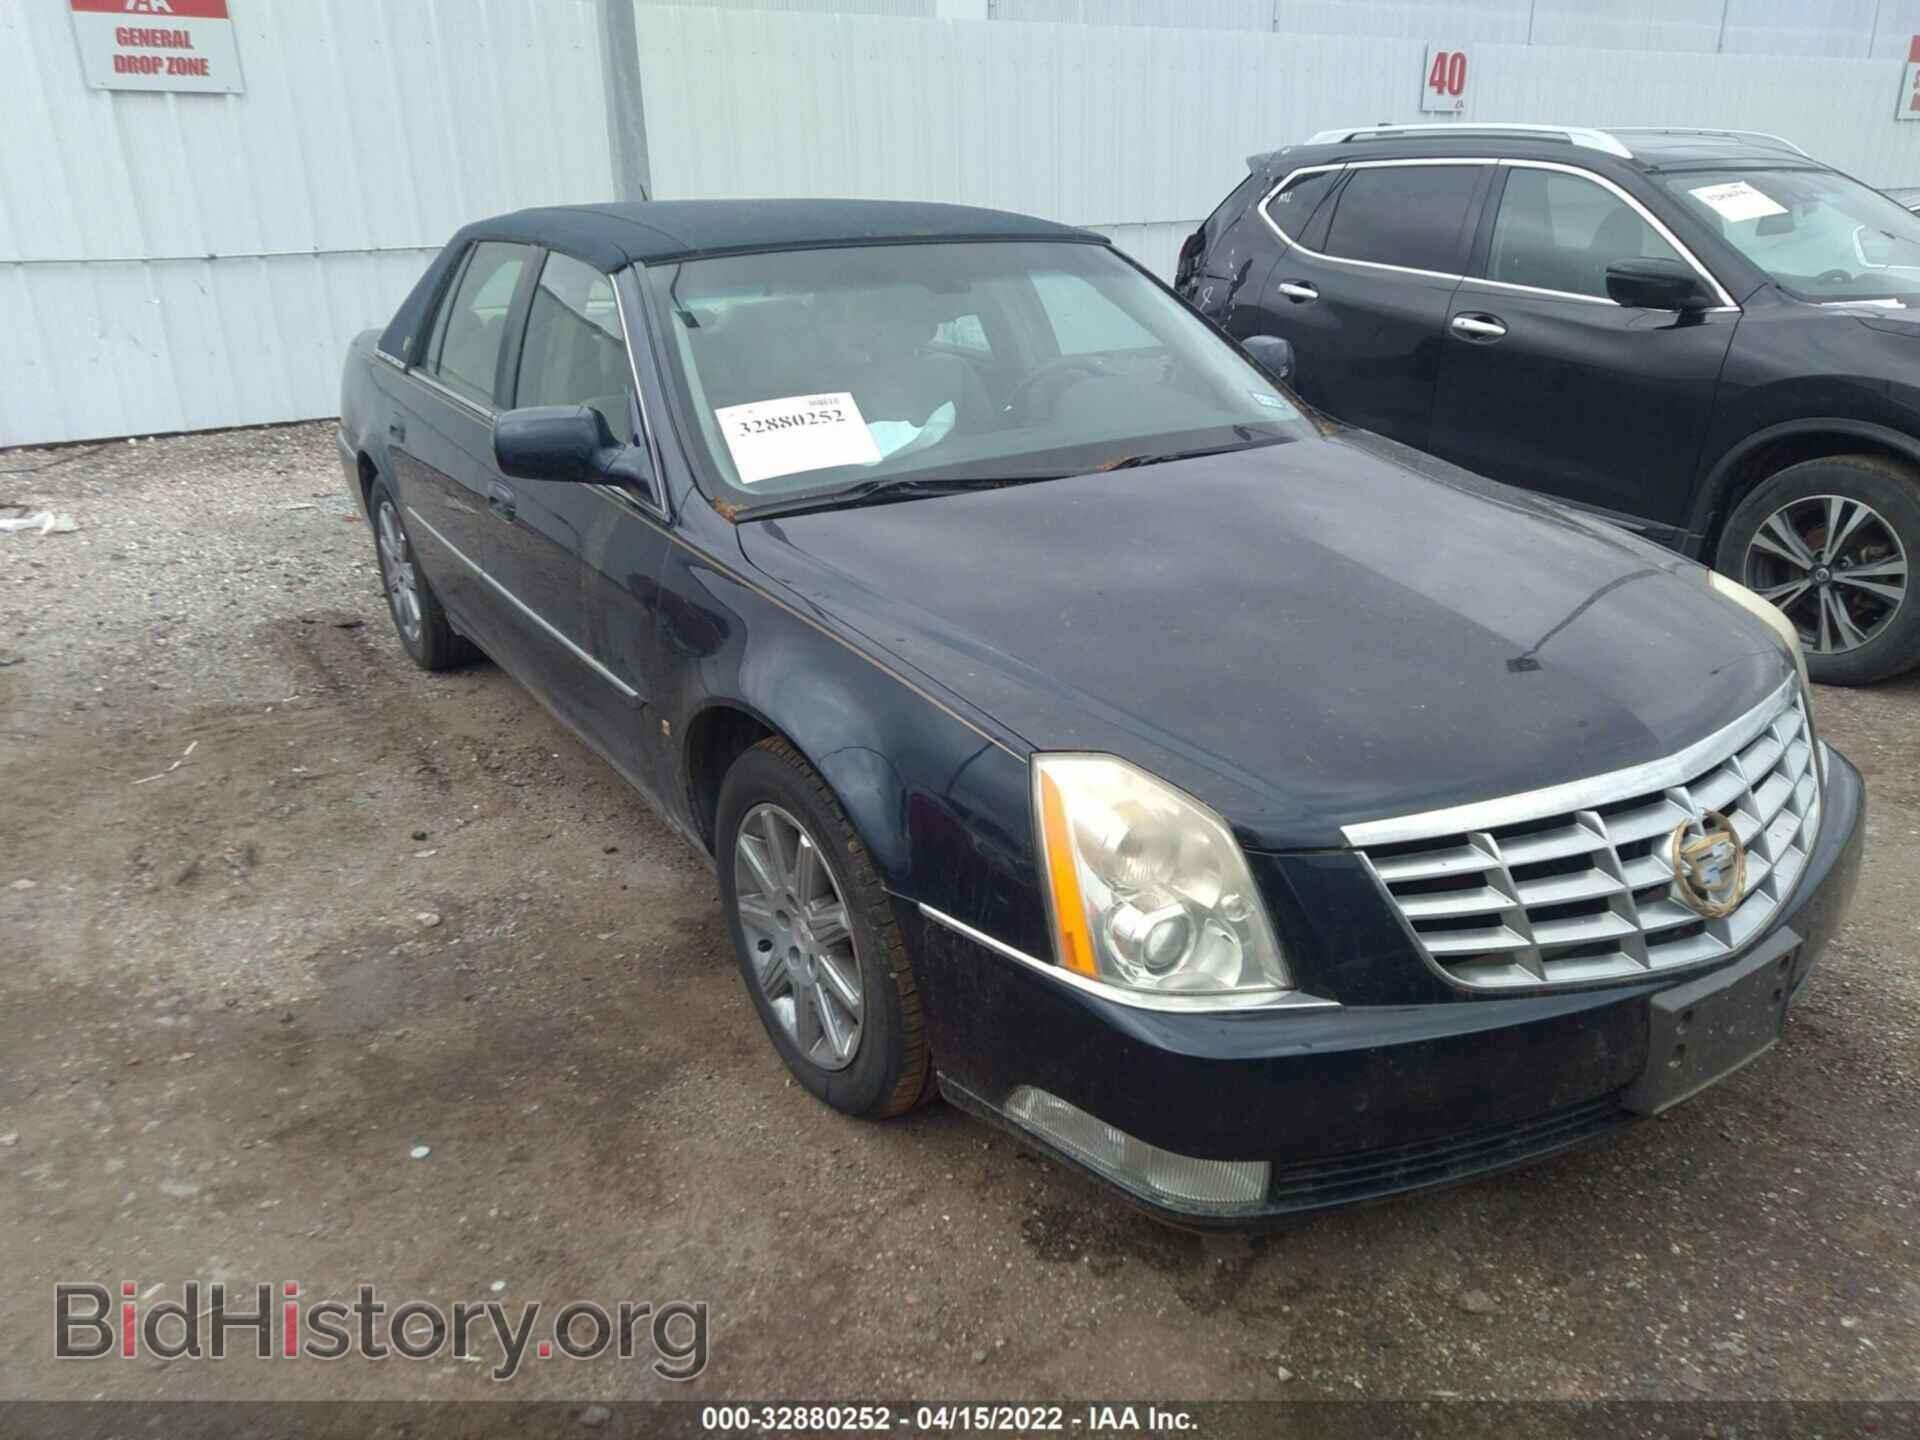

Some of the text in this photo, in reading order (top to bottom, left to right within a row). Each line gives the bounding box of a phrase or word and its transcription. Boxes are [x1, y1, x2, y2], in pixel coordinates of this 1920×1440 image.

[116, 26, 194, 49] GENERAL
[113, 54, 211, 76] DROP ZONE
[1429, 51, 1467, 96] 40
[739, 409, 846, 438] 32880252
